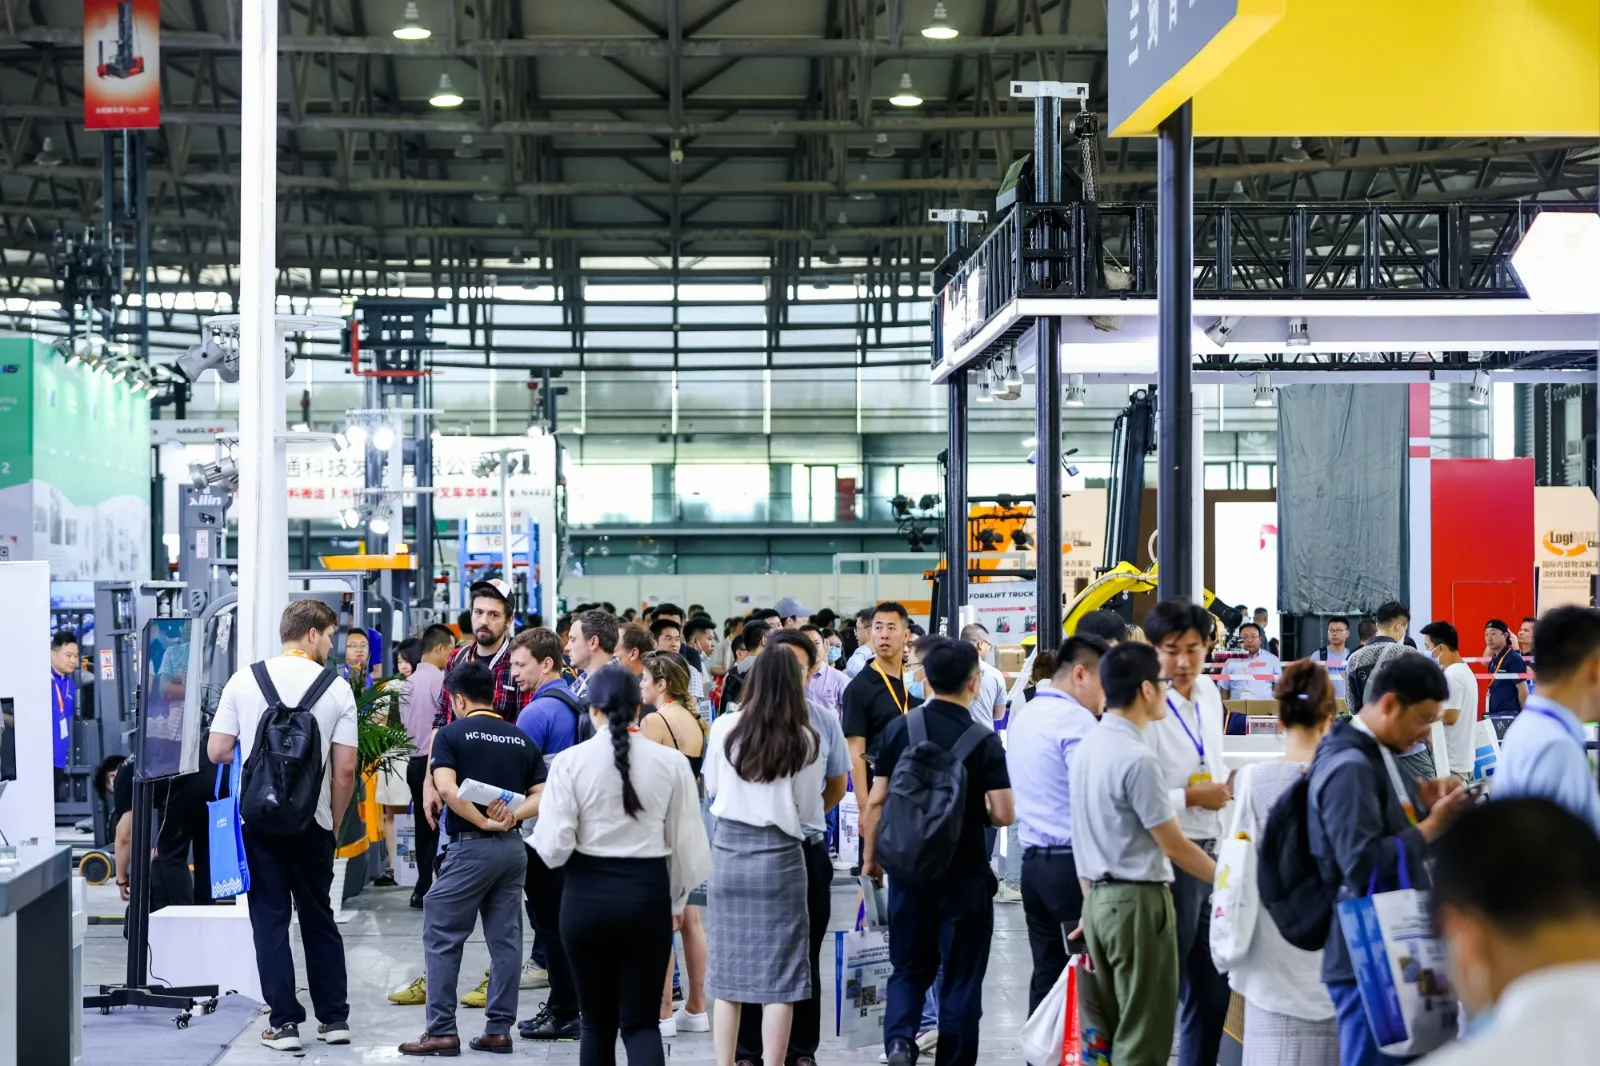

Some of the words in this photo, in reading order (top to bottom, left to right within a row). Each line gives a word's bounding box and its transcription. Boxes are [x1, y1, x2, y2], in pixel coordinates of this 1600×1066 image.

[969, 591, 1006, 599] FORKLIFT
[465, 731, 480, 741] HC
[480, 732, 526, 747] ROBOTICS
